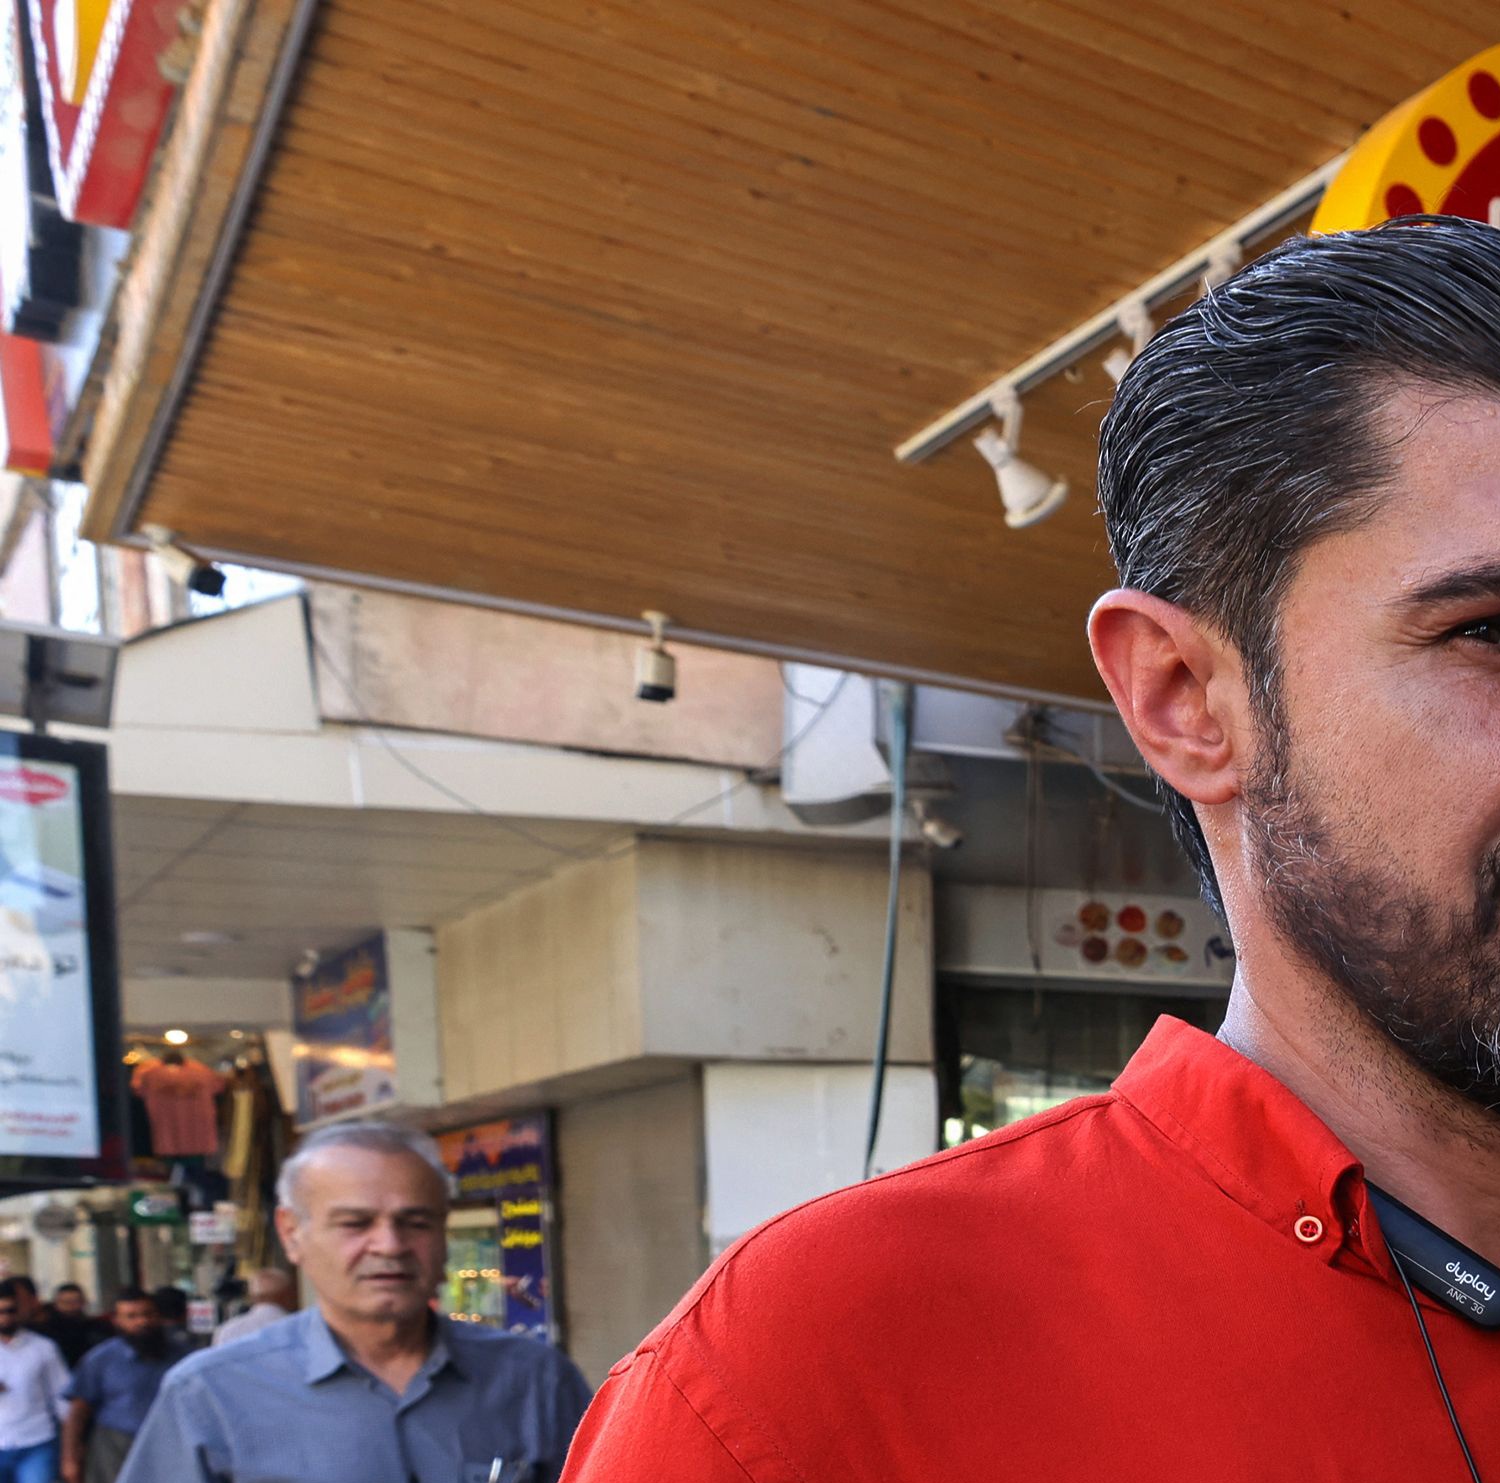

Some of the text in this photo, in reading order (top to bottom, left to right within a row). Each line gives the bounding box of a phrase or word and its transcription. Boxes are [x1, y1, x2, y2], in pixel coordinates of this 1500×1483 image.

[1445, 1261, 1496, 1301] dyplay
[1446, 1287, 1484, 1315] ANC 30
